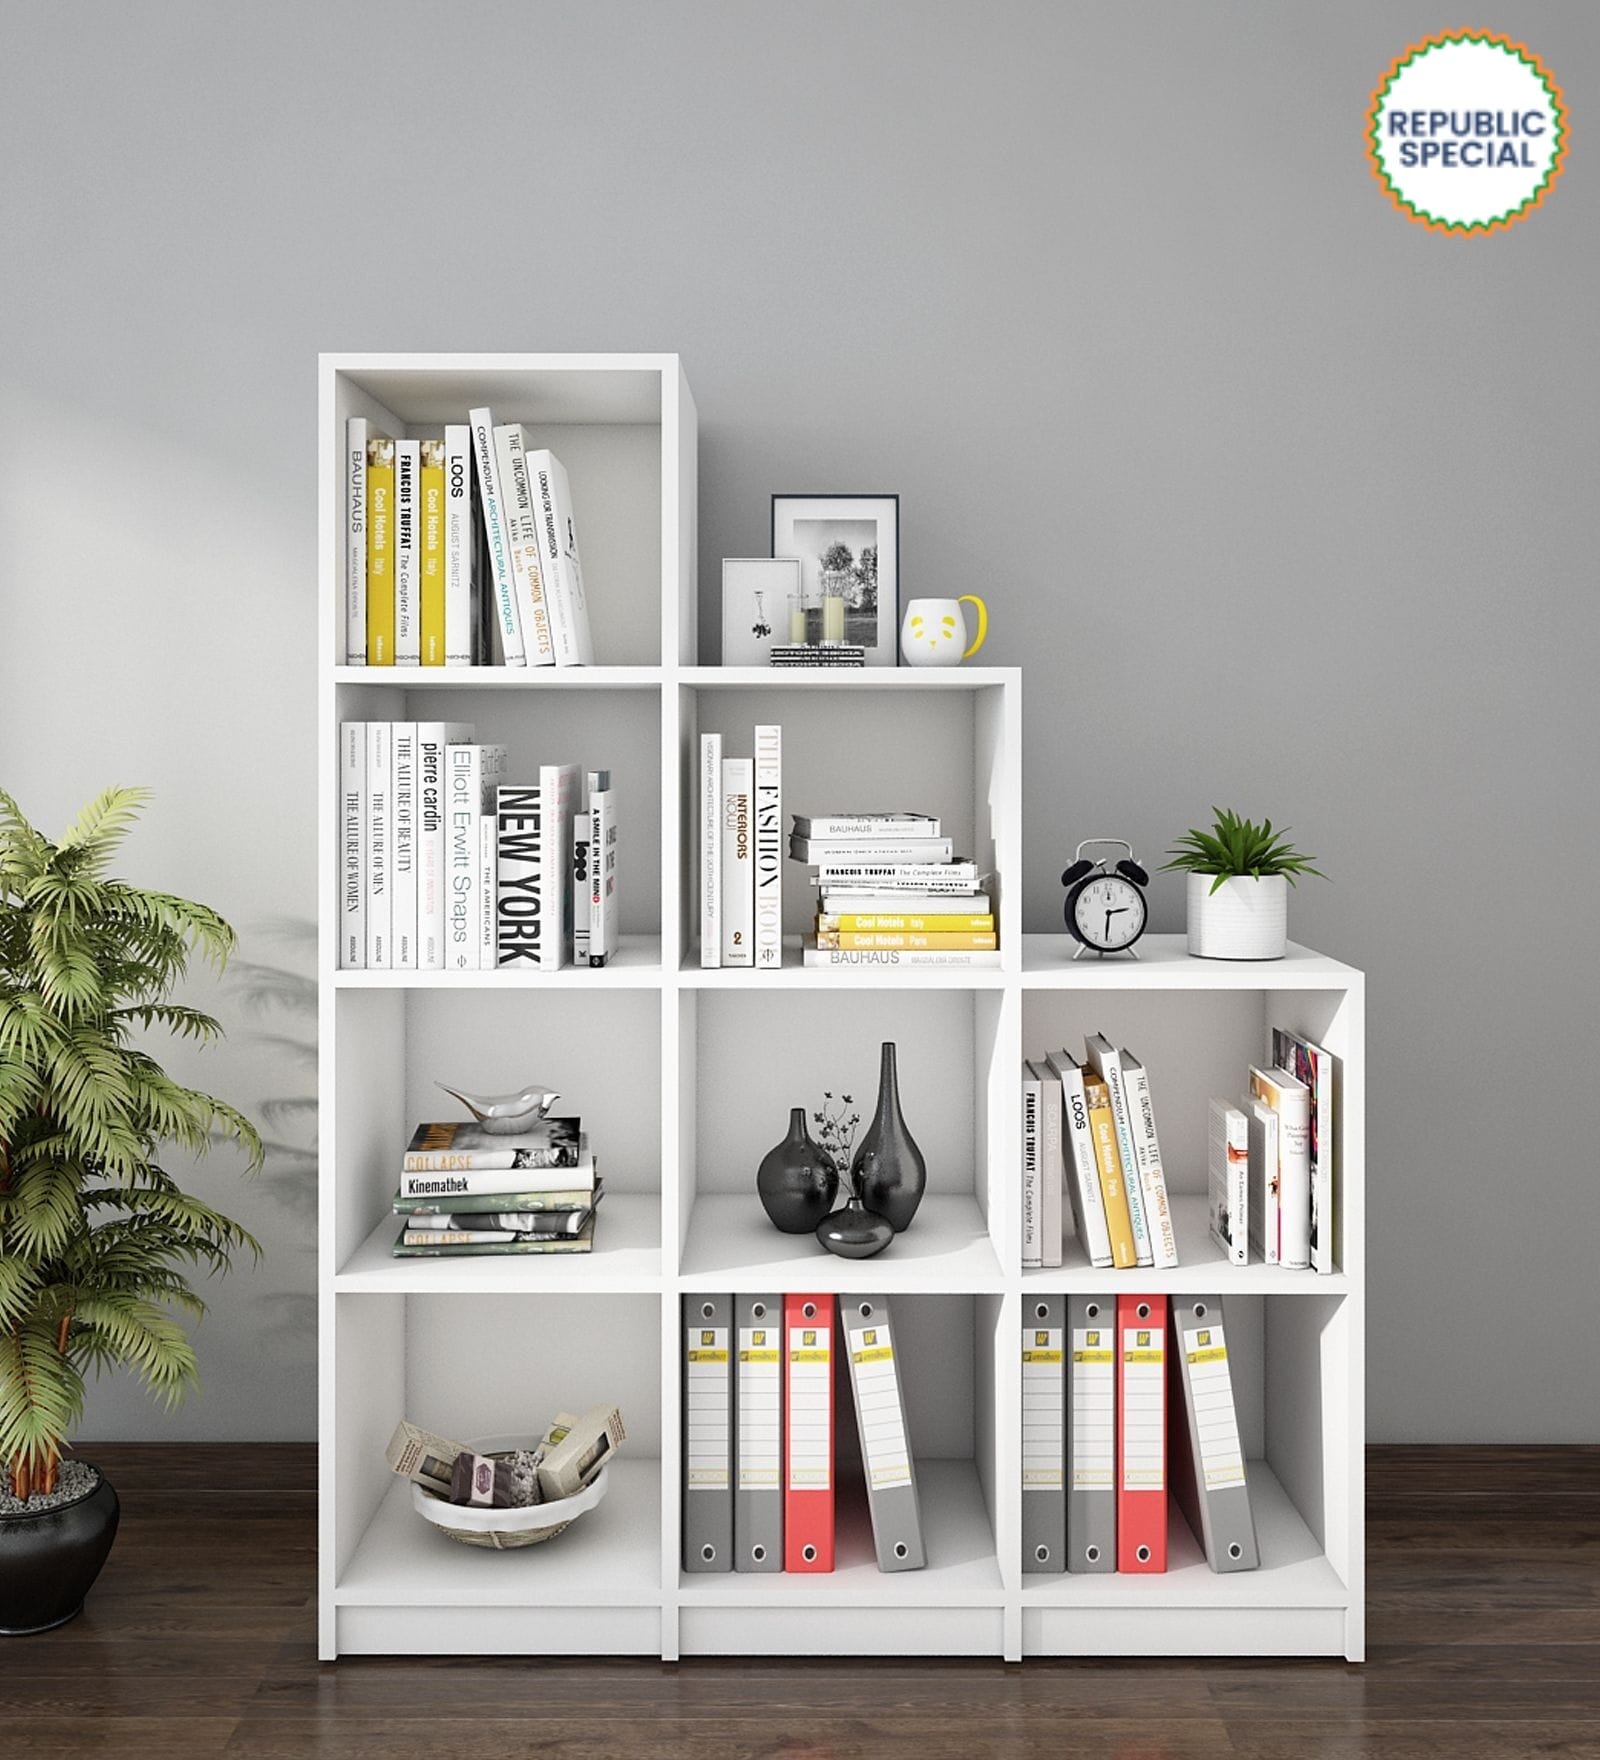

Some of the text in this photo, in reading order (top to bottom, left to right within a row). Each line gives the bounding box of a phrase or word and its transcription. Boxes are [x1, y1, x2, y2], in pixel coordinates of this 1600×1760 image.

[351, 451, 363, 534] BAUHAUS
[373, 487, 386, 576] Cool Hotels Italy
[425, 488, 439, 576] Cool Hotels Italy
[451, 455, 463, 588] LOOS AUGUST SARNITZ
[398, 455, 411, 638] FRANCOIS TRUFFAT The Complete Films
[508, 433, 550, 655] THE UNCOMMON LIFE OF COMMON OBJECTS
[487, 497, 506, 580] ARCHITECTURAL
[500, 583, 515, 636] ANTIQUES
[420, 743, 442, 783] pierre
[758, 728, 779, 778] THE
[397, 736, 411, 873] THE ALLURE OF BEAUTY
[423, 787, 442, 832] cardin
[593, 807, 600, 815] A
[372, 791, 384, 895] THE ALLURE OF MEN
[592, 817, 601, 844] SMILE
[737, 794, 748, 860] INTERIORS
[758, 785, 779, 887] FASHION
[829, 824, 872, 834] BAUHAUS
[346, 791, 359, 913] THE ALLURE OF WOMEN
[450, 751, 472, 943] Elliott Erwitt Snaps
[592, 847, 601, 858] IN
[483, 866, 491, 885] THE
[498, 789, 541, 965] NEW YORK
[592, 860, 601, 876] THE
[826, 868, 862, 876] FRANCOIS
[592, 878, 601, 904] MIND
[483, 888, 491, 947] AMERICANS
[855, 916, 876, 928] Cool
[877, 916, 904, 928] Hotels
[733, 931, 743, 945] 2
[830, 950, 900, 964] BAUHAUS
[853, 934, 927, 946] Cool Hotels Paris
[1137, 1076, 1146, 1092] THE
[1025, 1093, 1035, 1133] FRANCOIS
[1070, 1094, 1086, 1130] LOOS
[1140, 1096, 1154, 1139] UNCOMMON
[1098, 1123, 1111, 1143] Cool
[406, 1155, 473, 1170] COLLAPSE
[1025, 1136, 1035, 1172] TRUFFAT
[1102, 1145, 1115, 1174] Hotels
[1148, 1143, 1160, 1165] LIFE
[408, 1176, 469, 1194] Kinemathek
[1154, 1185, 1168, 1217] COMMON
[1130, 1196, 1145, 1240] ANTIQUES
[1160, 1220, 1175, 1258] OBJECTS
